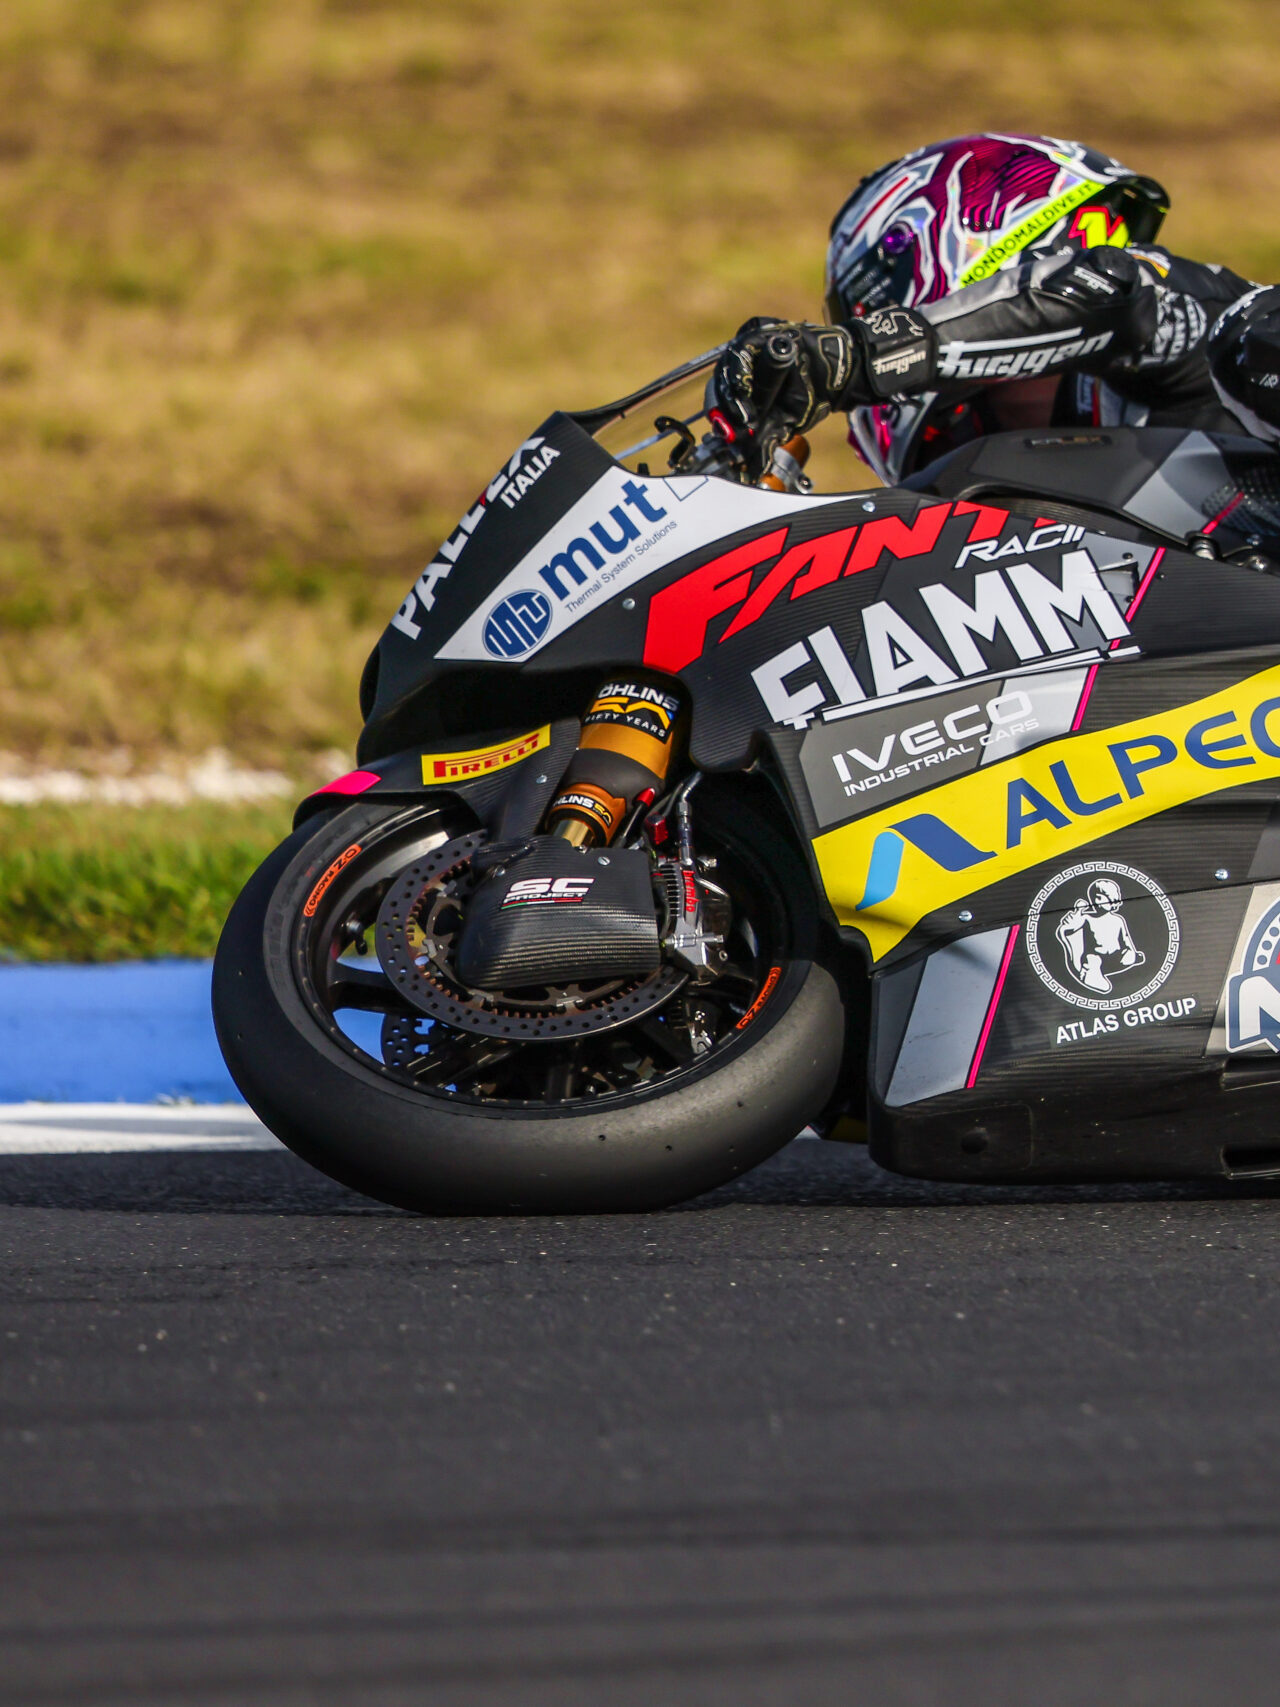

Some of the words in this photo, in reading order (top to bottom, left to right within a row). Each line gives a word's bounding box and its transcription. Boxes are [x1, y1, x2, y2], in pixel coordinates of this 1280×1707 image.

[500, 444, 561, 510] ITALIA
[538, 480, 668, 602] mut
[565, 580, 603, 613] Thermal
[601, 553, 636, 584] System
[635, 520, 678, 556] Solutions
[750, 549, 1134, 724] FIAMM
[433, 732, 540, 778] PIRELLI
[625, 714, 667, 738] YEARS
[831, 689, 1034, 783] IVECO
[844, 740, 975, 797] INDUSTRIAL
[979, 717, 1041, 749] CARS
[506, 877, 595, 898] SC
[682, 870, 700, 913] brembo
[1055, 1013, 1120, 1045] ATLAS
[1123, 997, 1197, 1028] GROUP
